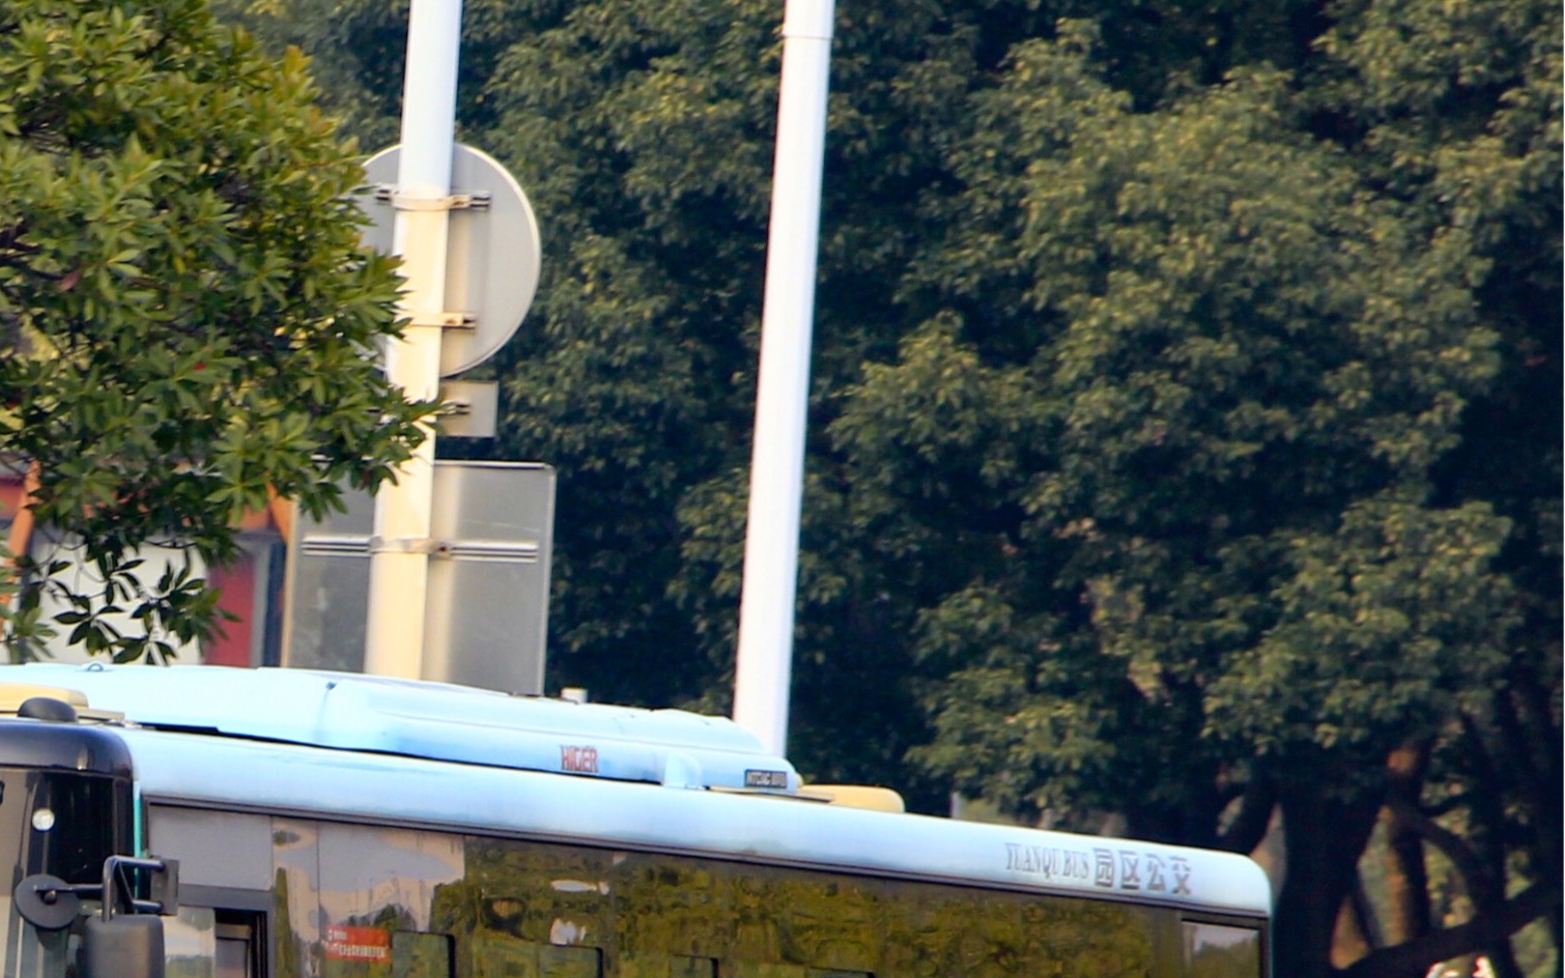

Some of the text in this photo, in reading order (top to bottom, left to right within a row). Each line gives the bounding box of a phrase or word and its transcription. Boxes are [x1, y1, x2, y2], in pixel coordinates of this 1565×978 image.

[560, 745, 598, 772] HIGER
[1063, 850, 1089, 879] BUS
[1093, 847, 1192, 895] 园区公交
